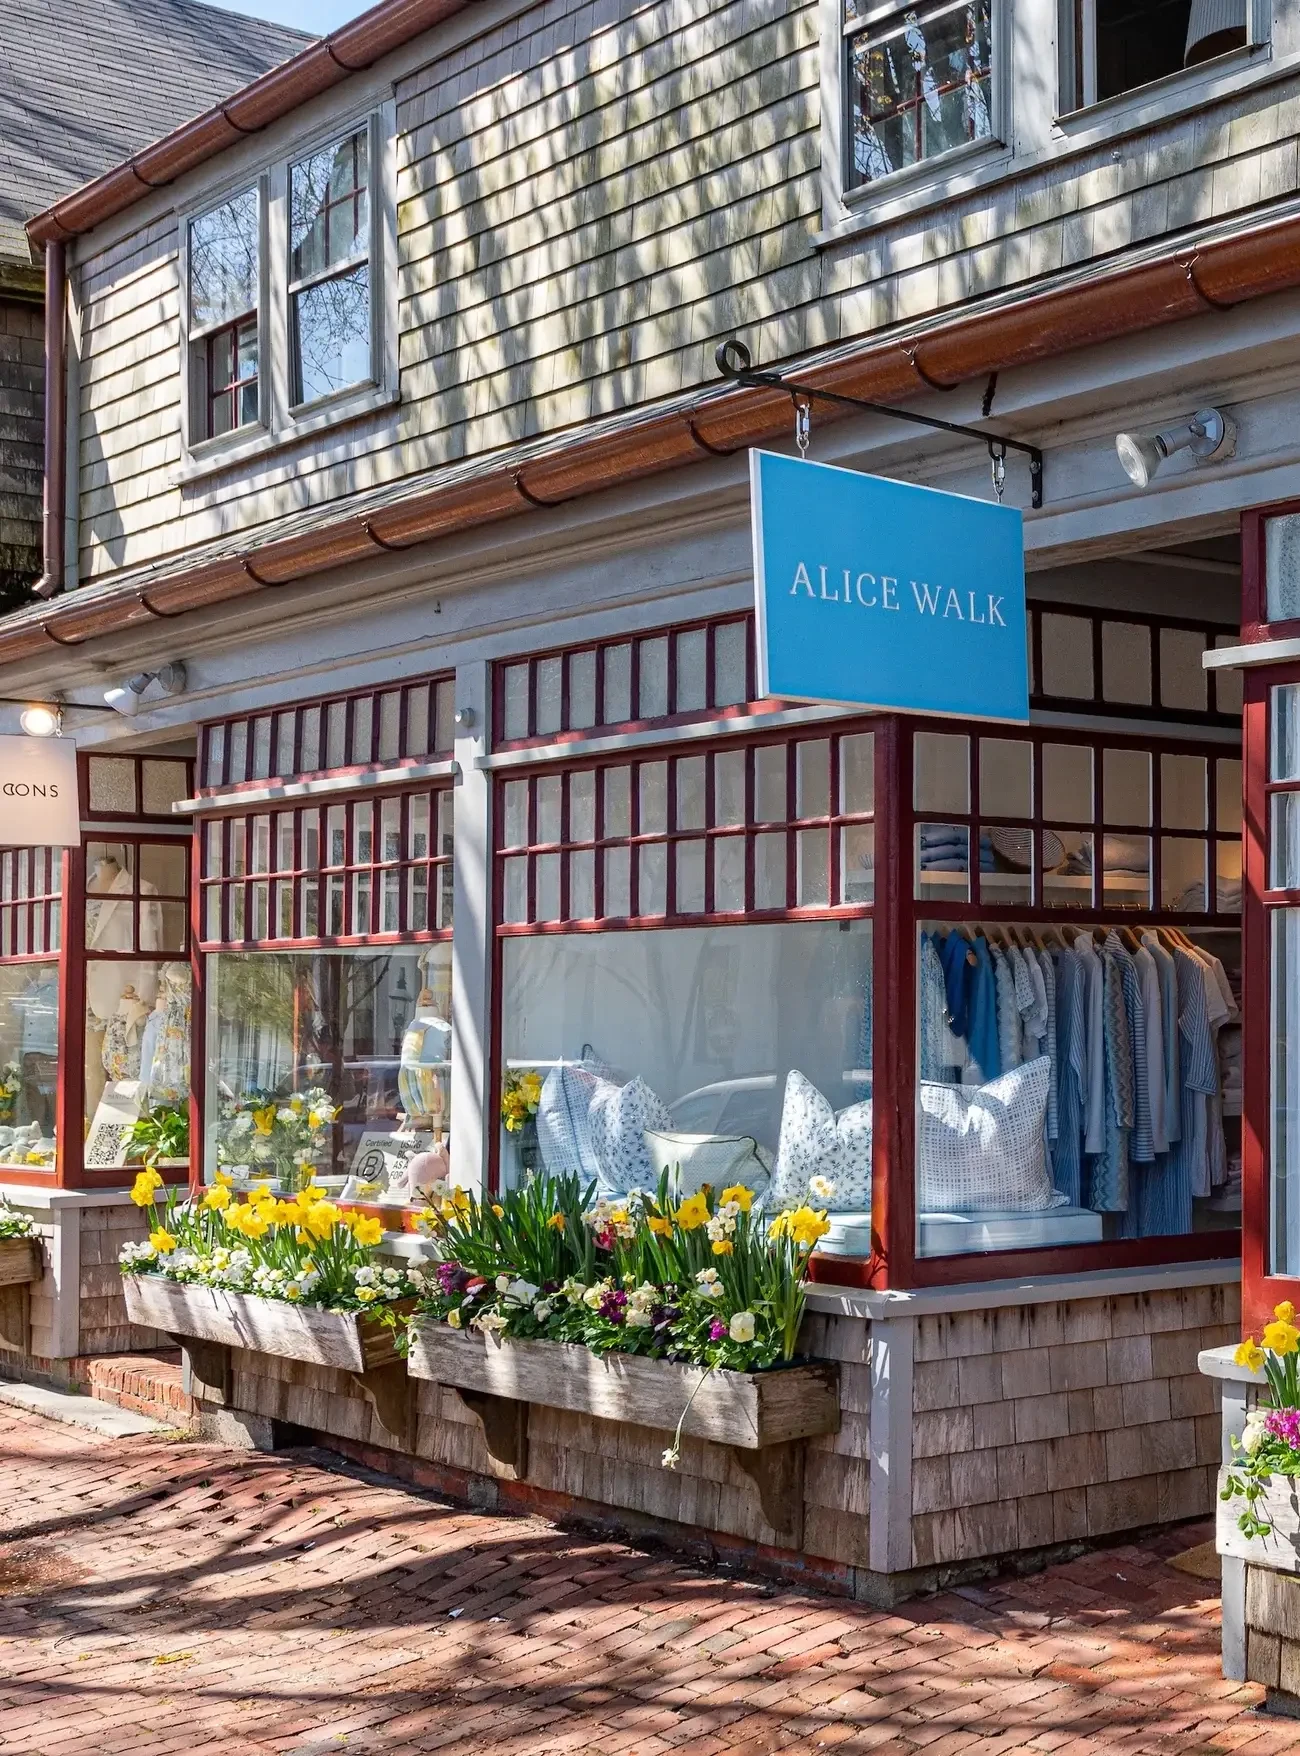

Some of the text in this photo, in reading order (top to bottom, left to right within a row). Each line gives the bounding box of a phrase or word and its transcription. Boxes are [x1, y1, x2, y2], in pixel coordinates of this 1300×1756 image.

[789, 561, 1007, 627] ALICE WALK
[365, 1139, 393, 1147] Certified
[392, 1161, 403, 1169] AS
